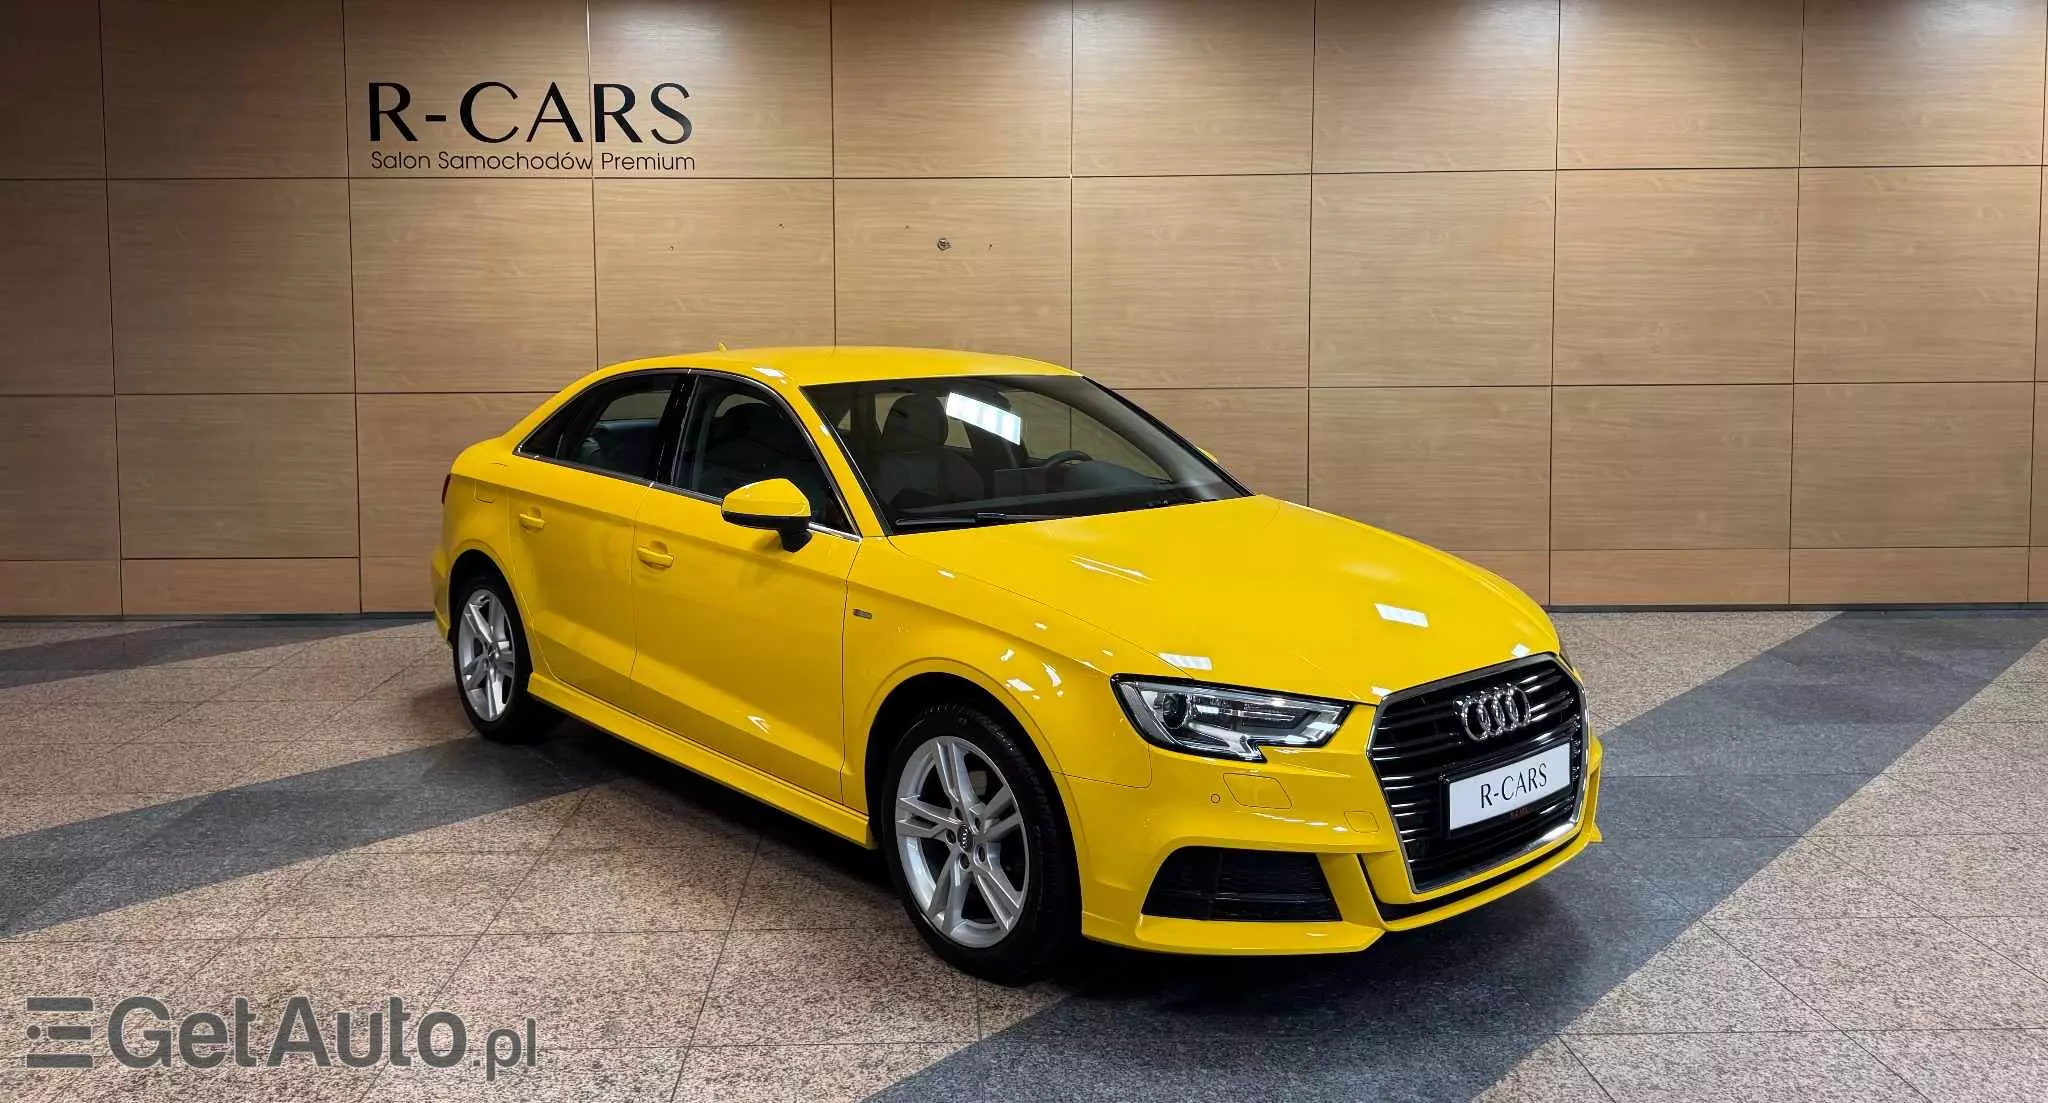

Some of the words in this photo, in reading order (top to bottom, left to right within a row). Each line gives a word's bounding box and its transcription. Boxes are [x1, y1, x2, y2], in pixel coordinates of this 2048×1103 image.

[368, 81, 693, 144] R-CARS
[371, 151, 431, 170] Salon
[438, 151, 593, 170] Samochodów
[601, 152, 696, 171] Premium
[1480, 763, 1547, 808] R-CARS
